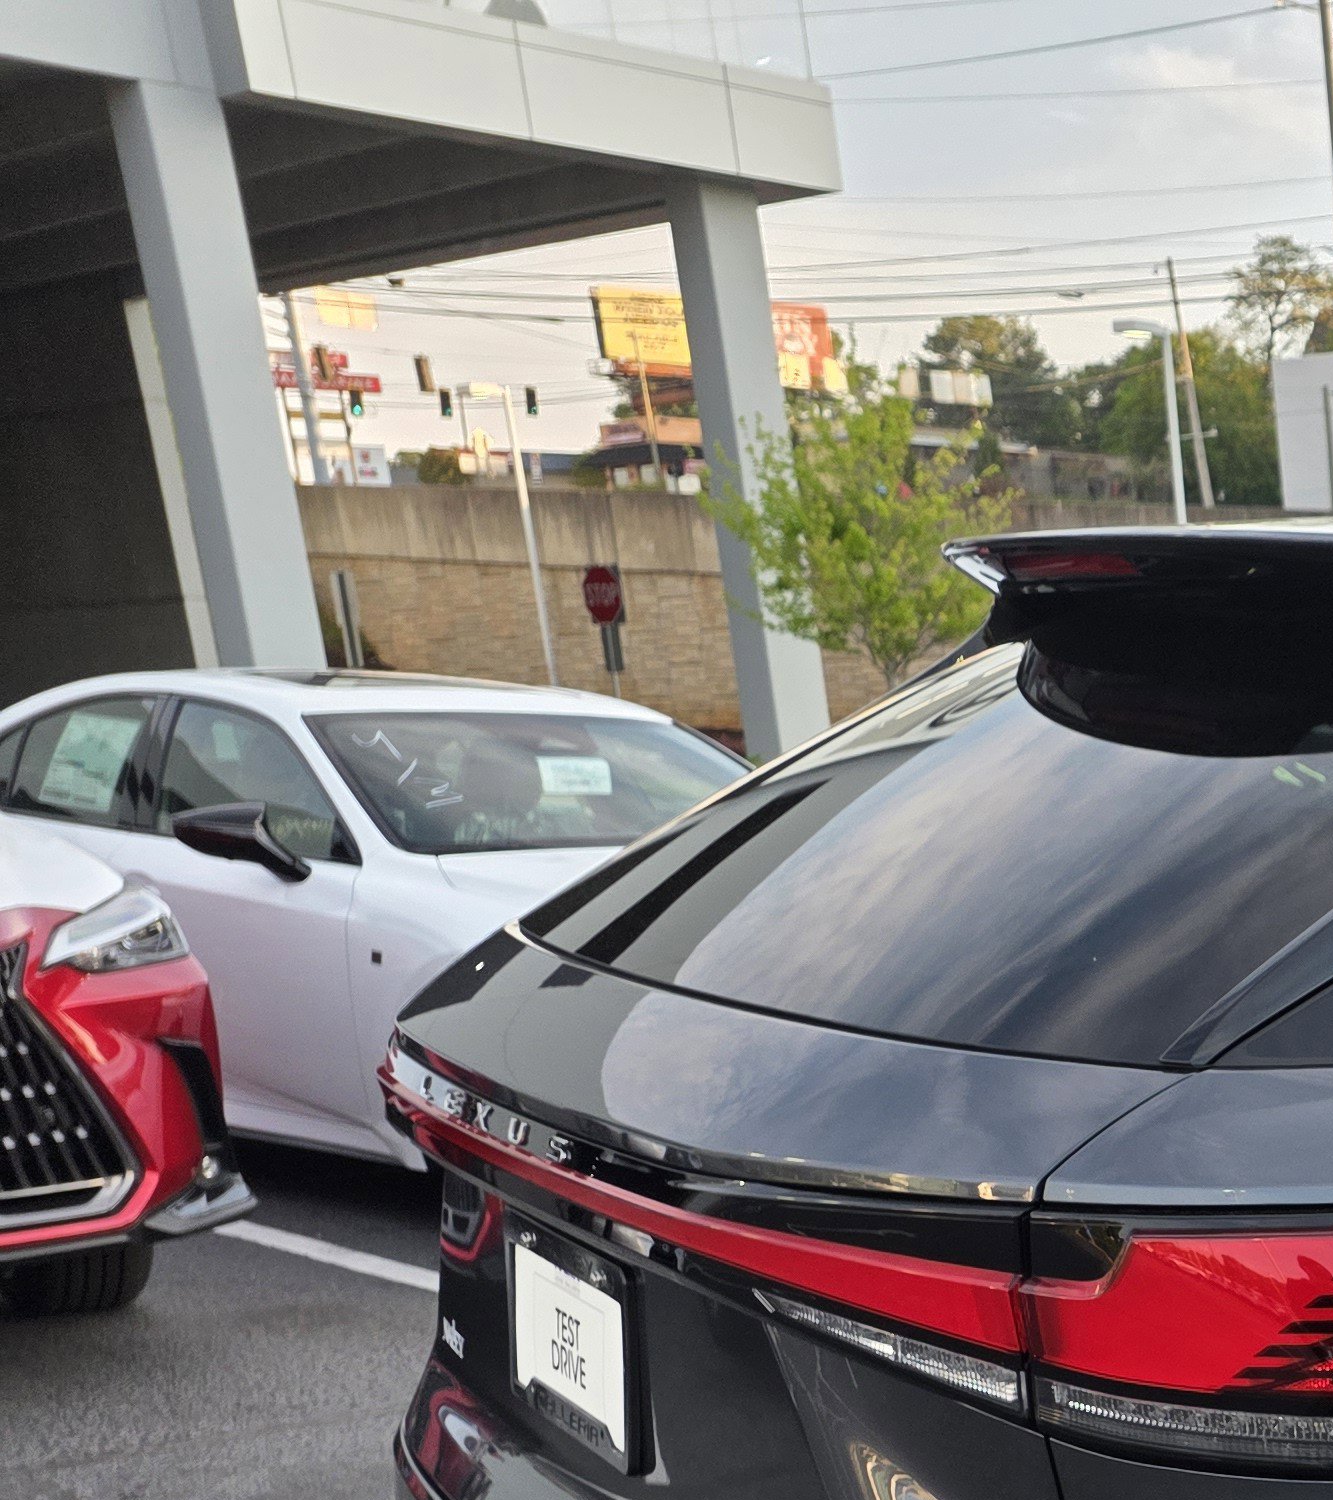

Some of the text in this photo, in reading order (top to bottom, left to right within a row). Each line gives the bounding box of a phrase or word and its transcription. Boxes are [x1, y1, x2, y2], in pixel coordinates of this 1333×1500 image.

[585, 582, 620, 607] STOP
[420, 1075, 574, 1163] LEXUS
[555, 1306, 581, 1351] TEST
[551, 1338, 587, 1390] DRIVE
